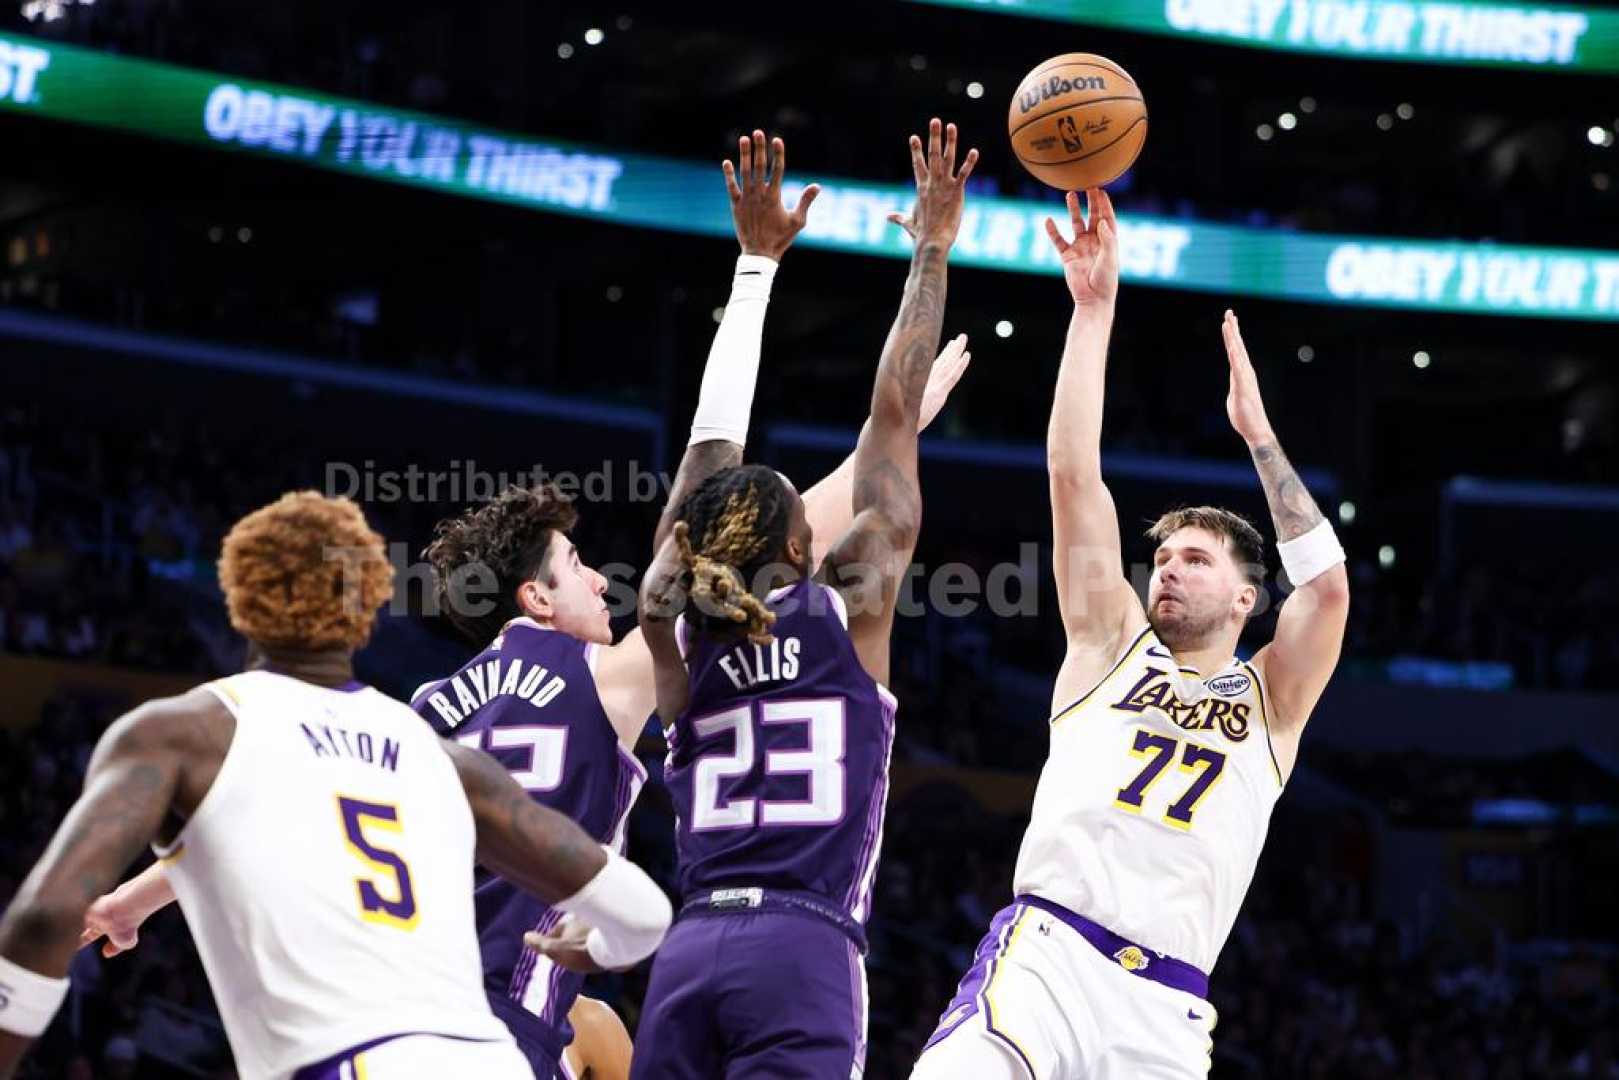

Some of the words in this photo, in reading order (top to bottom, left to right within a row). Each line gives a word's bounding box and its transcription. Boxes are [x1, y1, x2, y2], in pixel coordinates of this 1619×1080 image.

[1423, 6, 1587, 64] THIRST
[1020, 76, 1106, 113] Wilson
[205, 83, 336, 155] OBEY
[466, 136, 622, 211] THIRST
[428, 659, 566, 727] RAYNAUD
[718, 637, 801, 690] ELLIS
[1111, 667, 1251, 742] LAKERS
[300, 722, 400, 772] AYTON
[457, 725, 569, 792] 2
[690, 698, 846, 831] 23
[1112, 729, 1229, 832] 77
[334, 791, 420, 932] 5
